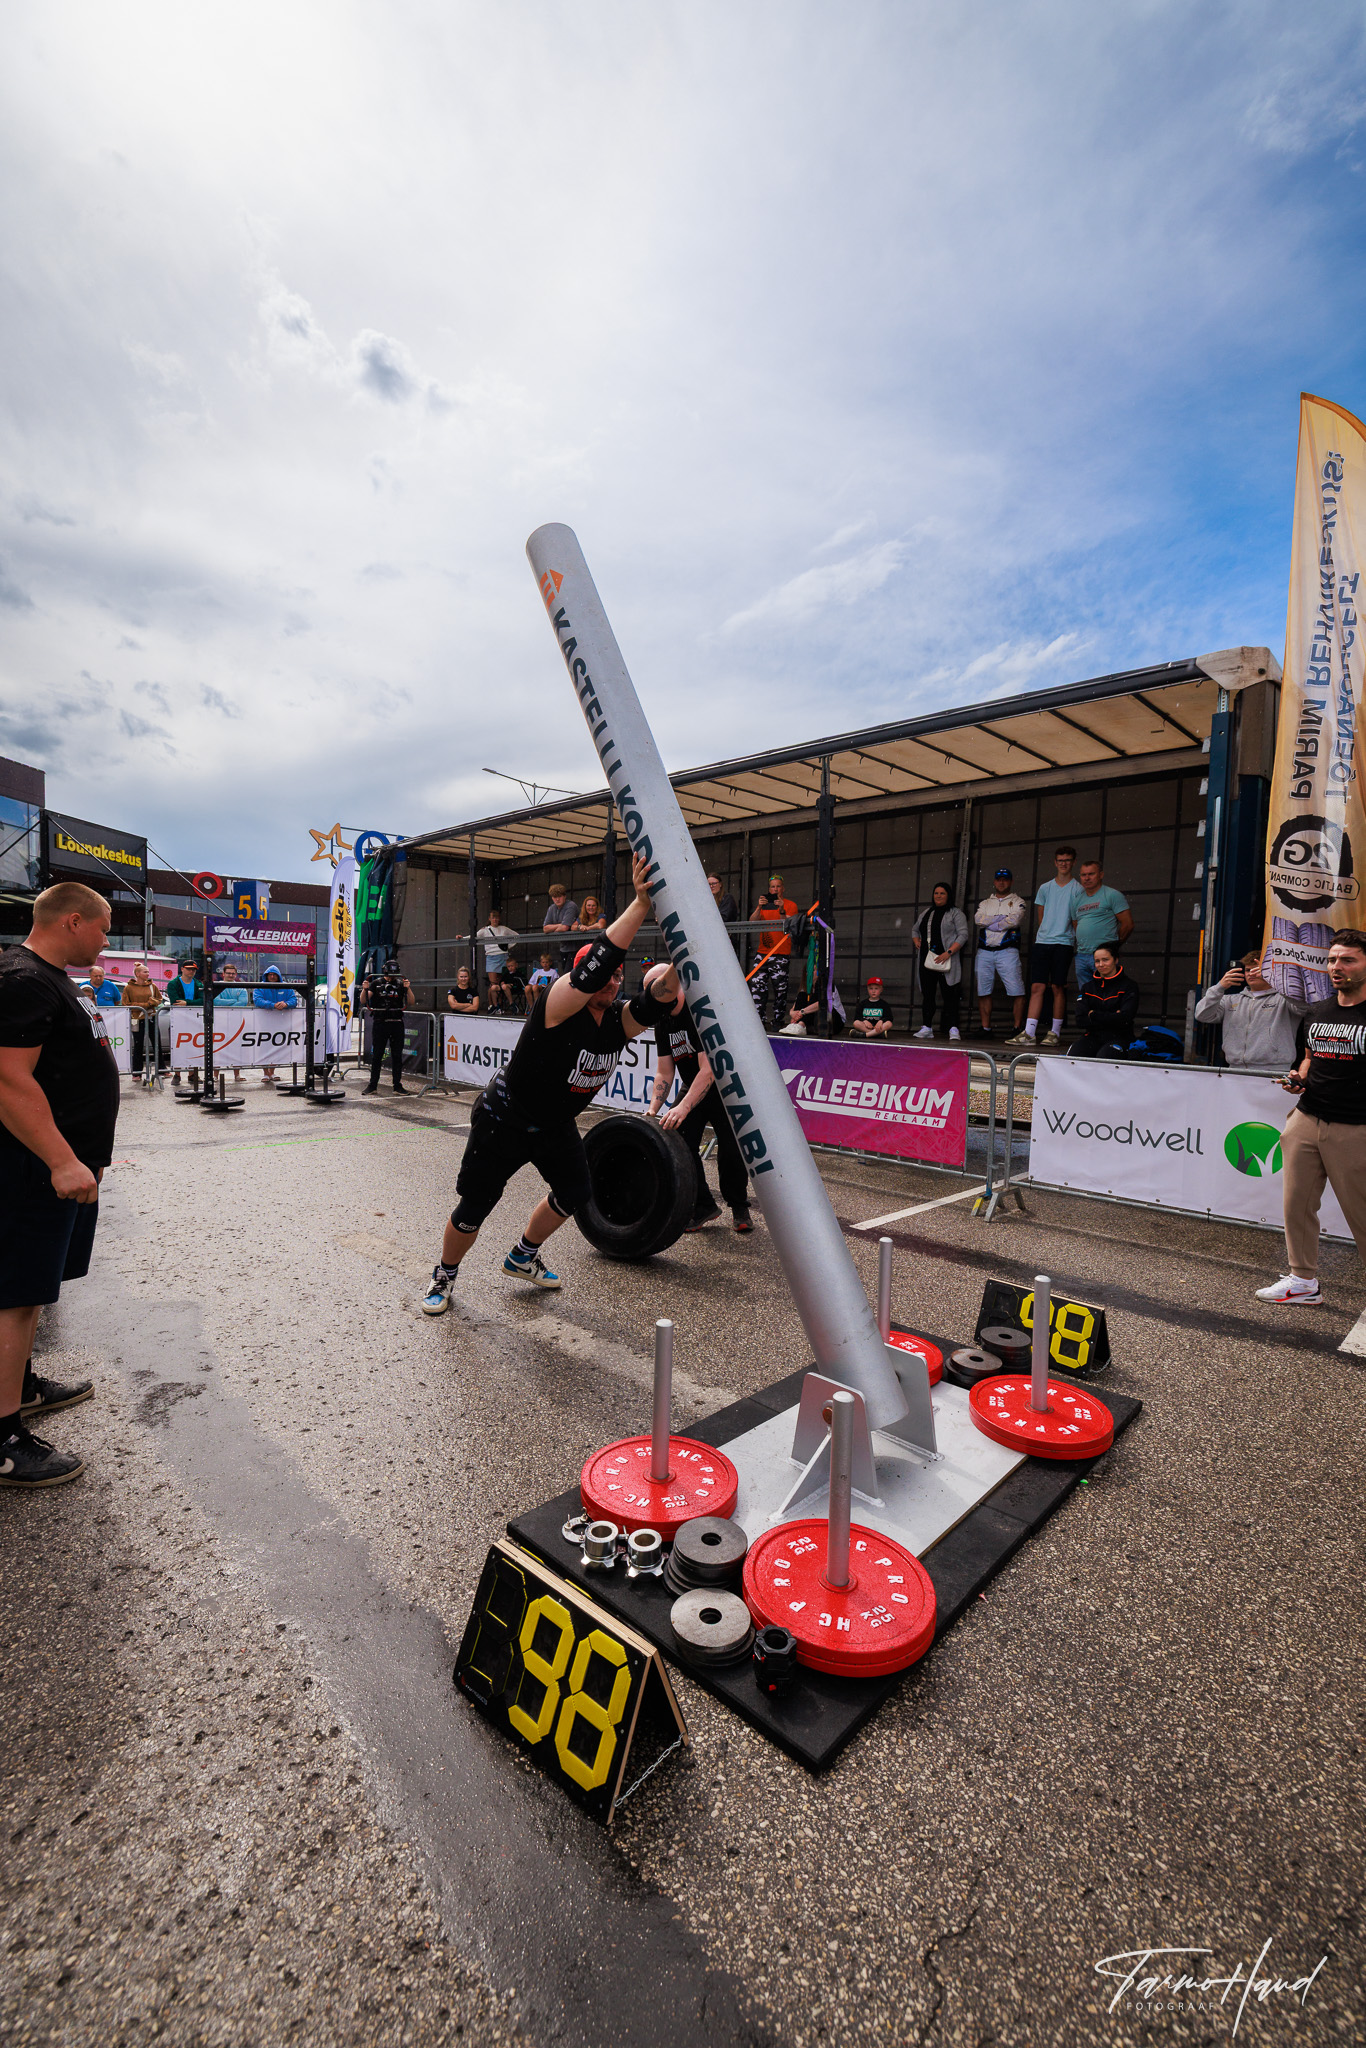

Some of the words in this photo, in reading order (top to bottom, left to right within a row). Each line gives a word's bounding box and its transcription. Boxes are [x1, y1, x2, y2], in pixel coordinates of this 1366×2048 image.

[55, 833, 142, 867] Lõunakeskus
[239, 929, 311, 943] KLEEBIKUM
[335, 882, 350, 1030] Lõunakeskus
[176, 1032, 225, 1048] POP
[462, 1043, 515, 1068] KASTE
[660, 911, 700, 991] MIS
[690, 994, 774, 1179] KESTAB!
[796, 1075, 954, 1117] KLEEBIKUM
[875, 1111, 940, 1126] REKLAAM
[1043, 1109, 1204, 1155] Woodwell
[773, 1558, 807, 1613] PRO
[874, 1557, 909, 1604] PRO
[818, 1612, 850, 1632] HC
[860, 1611, 882, 1628] KG
[872, 1605, 895, 1622] 25
[507, 1594, 632, 1792] 98
